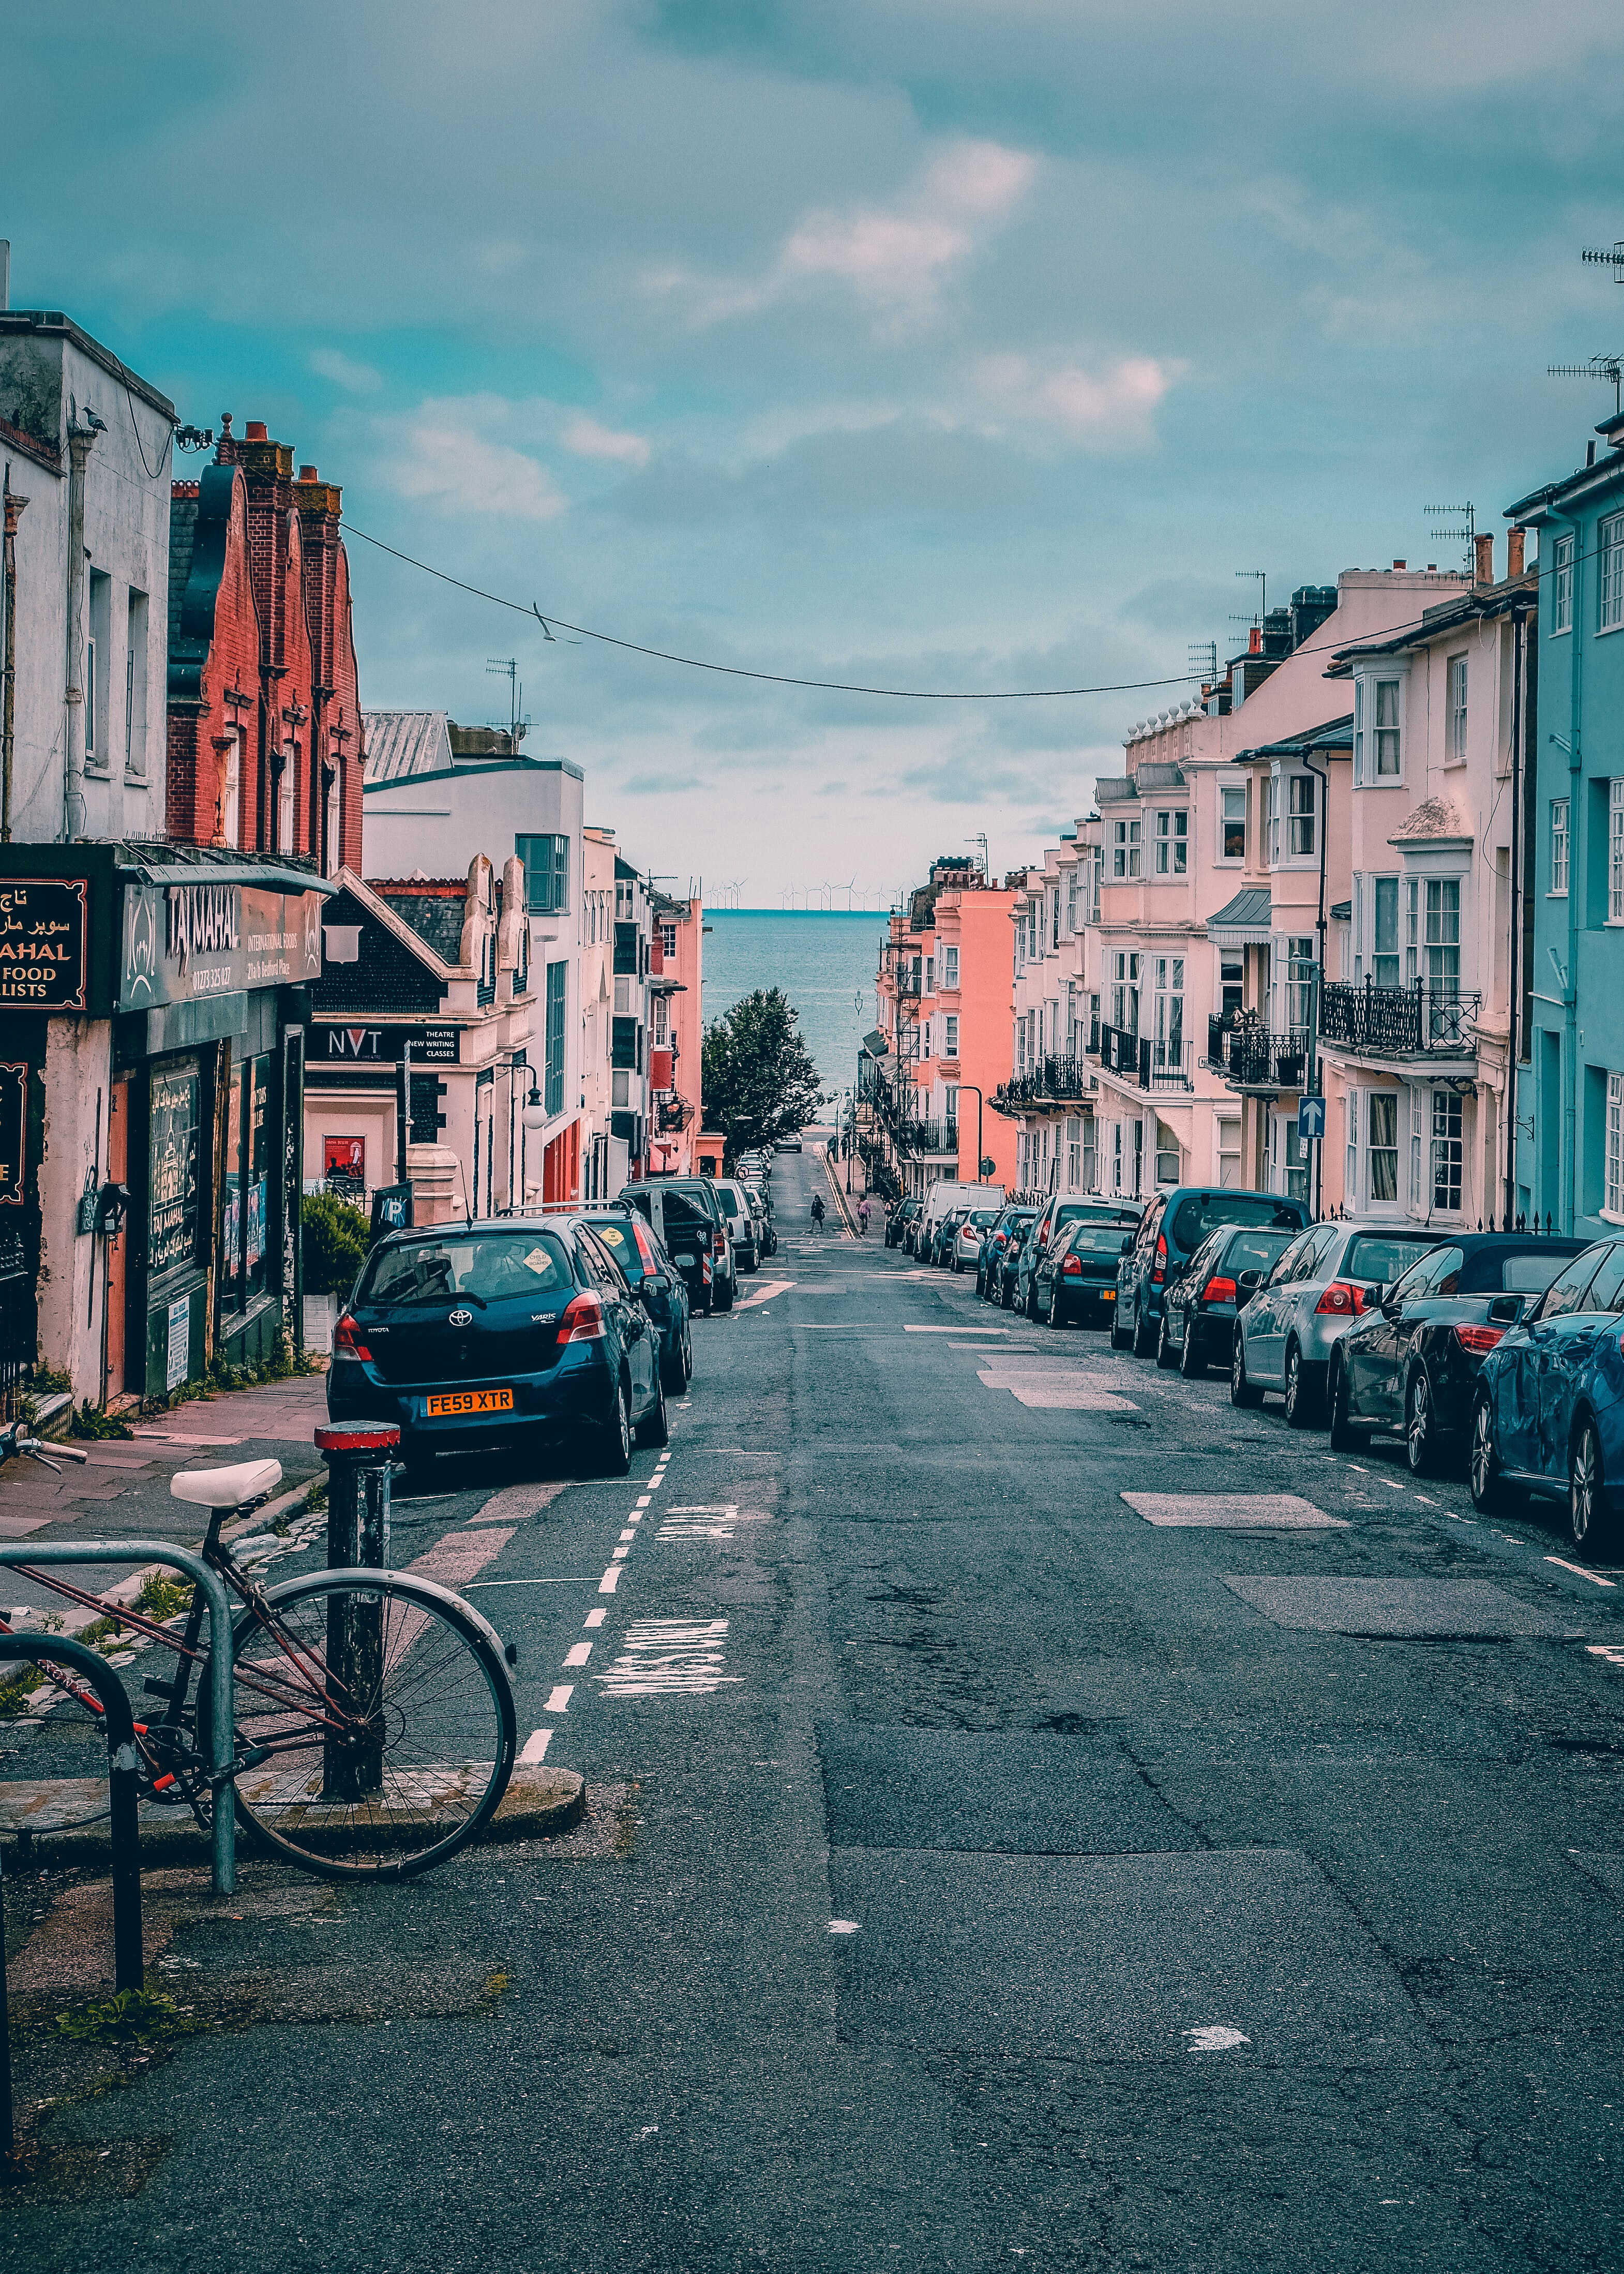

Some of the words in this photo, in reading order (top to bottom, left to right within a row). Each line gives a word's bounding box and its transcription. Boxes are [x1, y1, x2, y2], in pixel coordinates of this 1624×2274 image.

[1, 889, 26, 912] تاج
[0, 915, 23, 935] مار
[169, 886, 190, 976] TAJ
[192, 885, 239, 952] MAHAL
[0, 942, 71, 961] AHAL
[248, 933, 283, 952] INTERNATIONAL
[283, 933, 298, 949] FOODS
[3, 967, 56, 981] FOOD
[261, 959, 279, 978] Bedford
[279, 958, 290, 976] Place
[193, 969, 209, 991] 01273
[210, 967, 221, 988] 325
[221, 966, 231, 986] 027
[0, 983, 47, 997] LISTS
[329, 1028, 382, 1057] NVT
[389, 1201, 402, 1222] P
[153, 1213, 163, 1239] TAJ
[163, 1205, 185, 1230] MAHAL
[531, 1312, 557, 1322] YARIS
[430, 1394, 473, 1413] FE59
[477, 1391, 510, 1409] XTR
